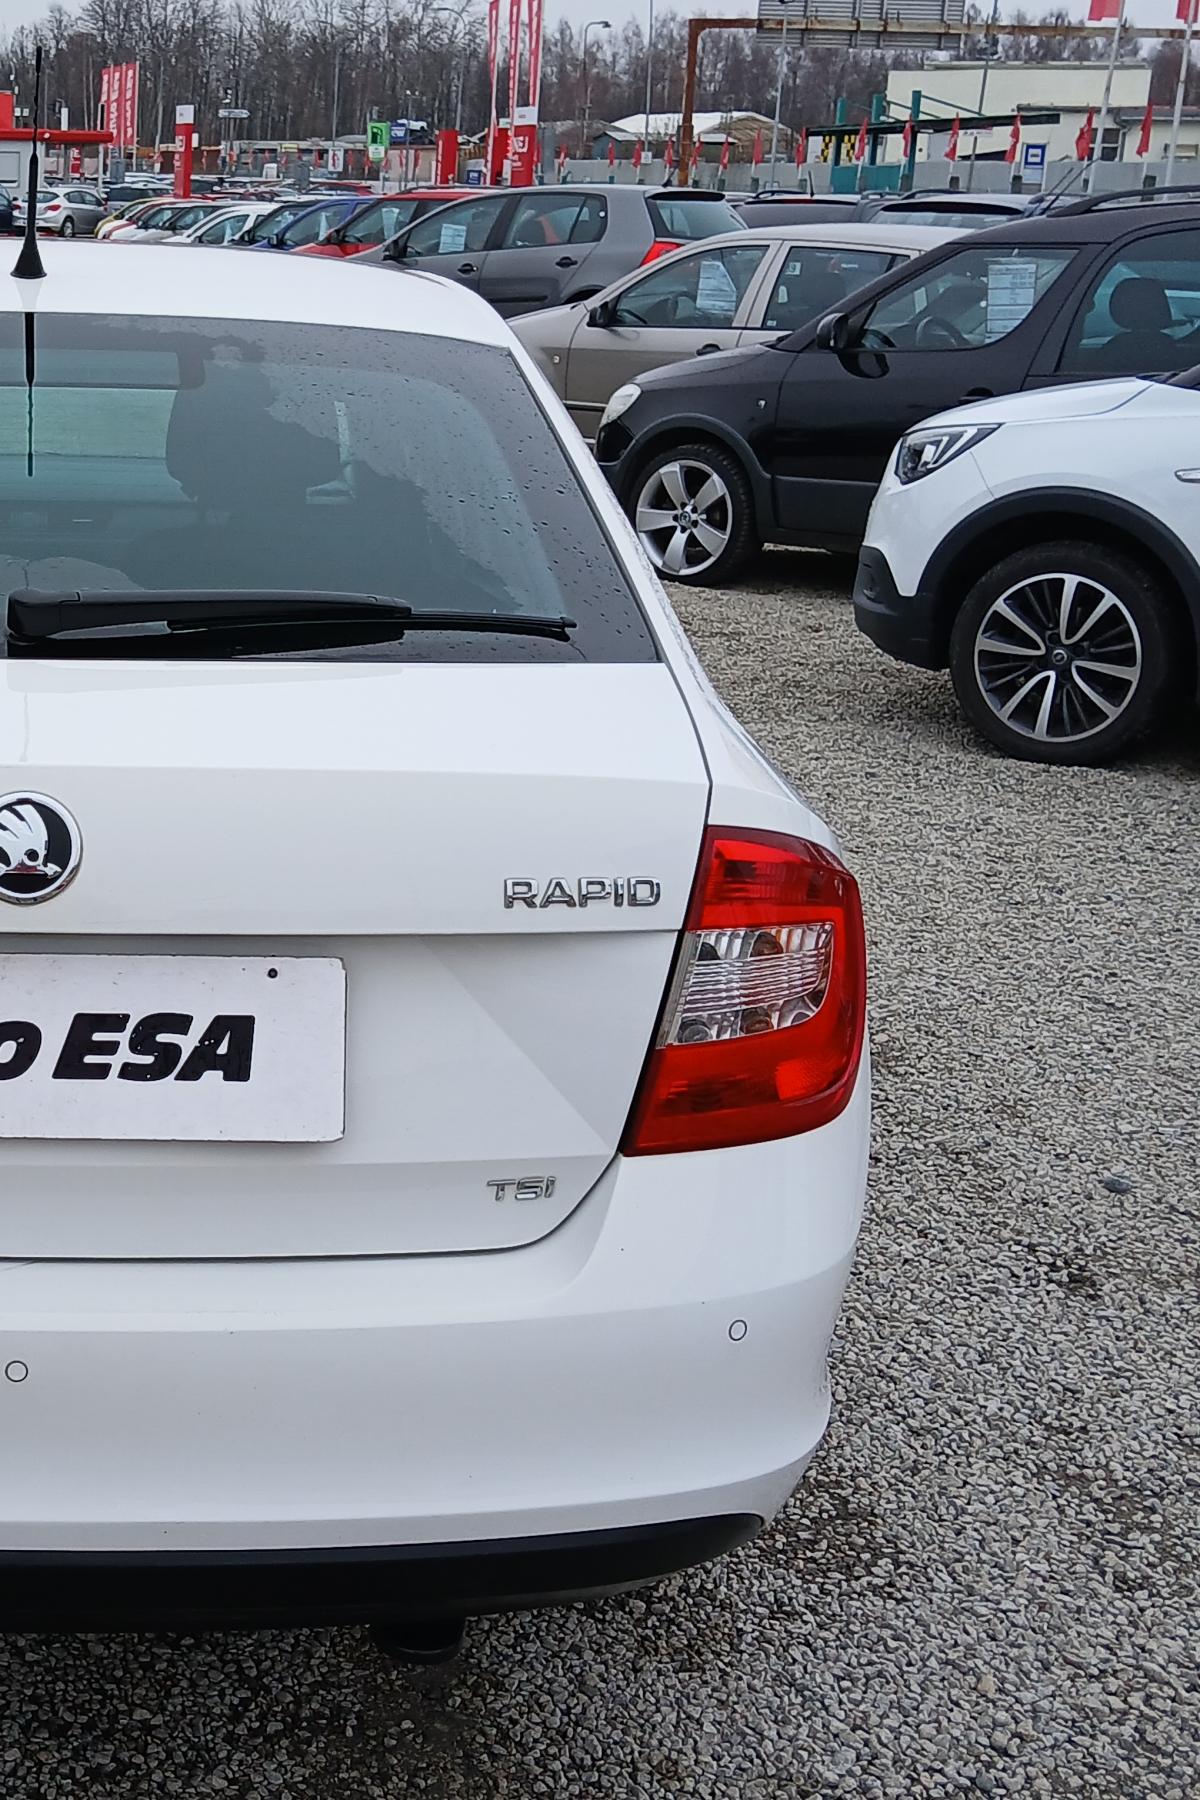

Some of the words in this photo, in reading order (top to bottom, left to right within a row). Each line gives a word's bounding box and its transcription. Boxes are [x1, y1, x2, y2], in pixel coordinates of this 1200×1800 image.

[503, 876, 661, 908] RAPID
[51, 1012, 256, 1082] ESA
[486, 1175, 557, 1201] TSI
